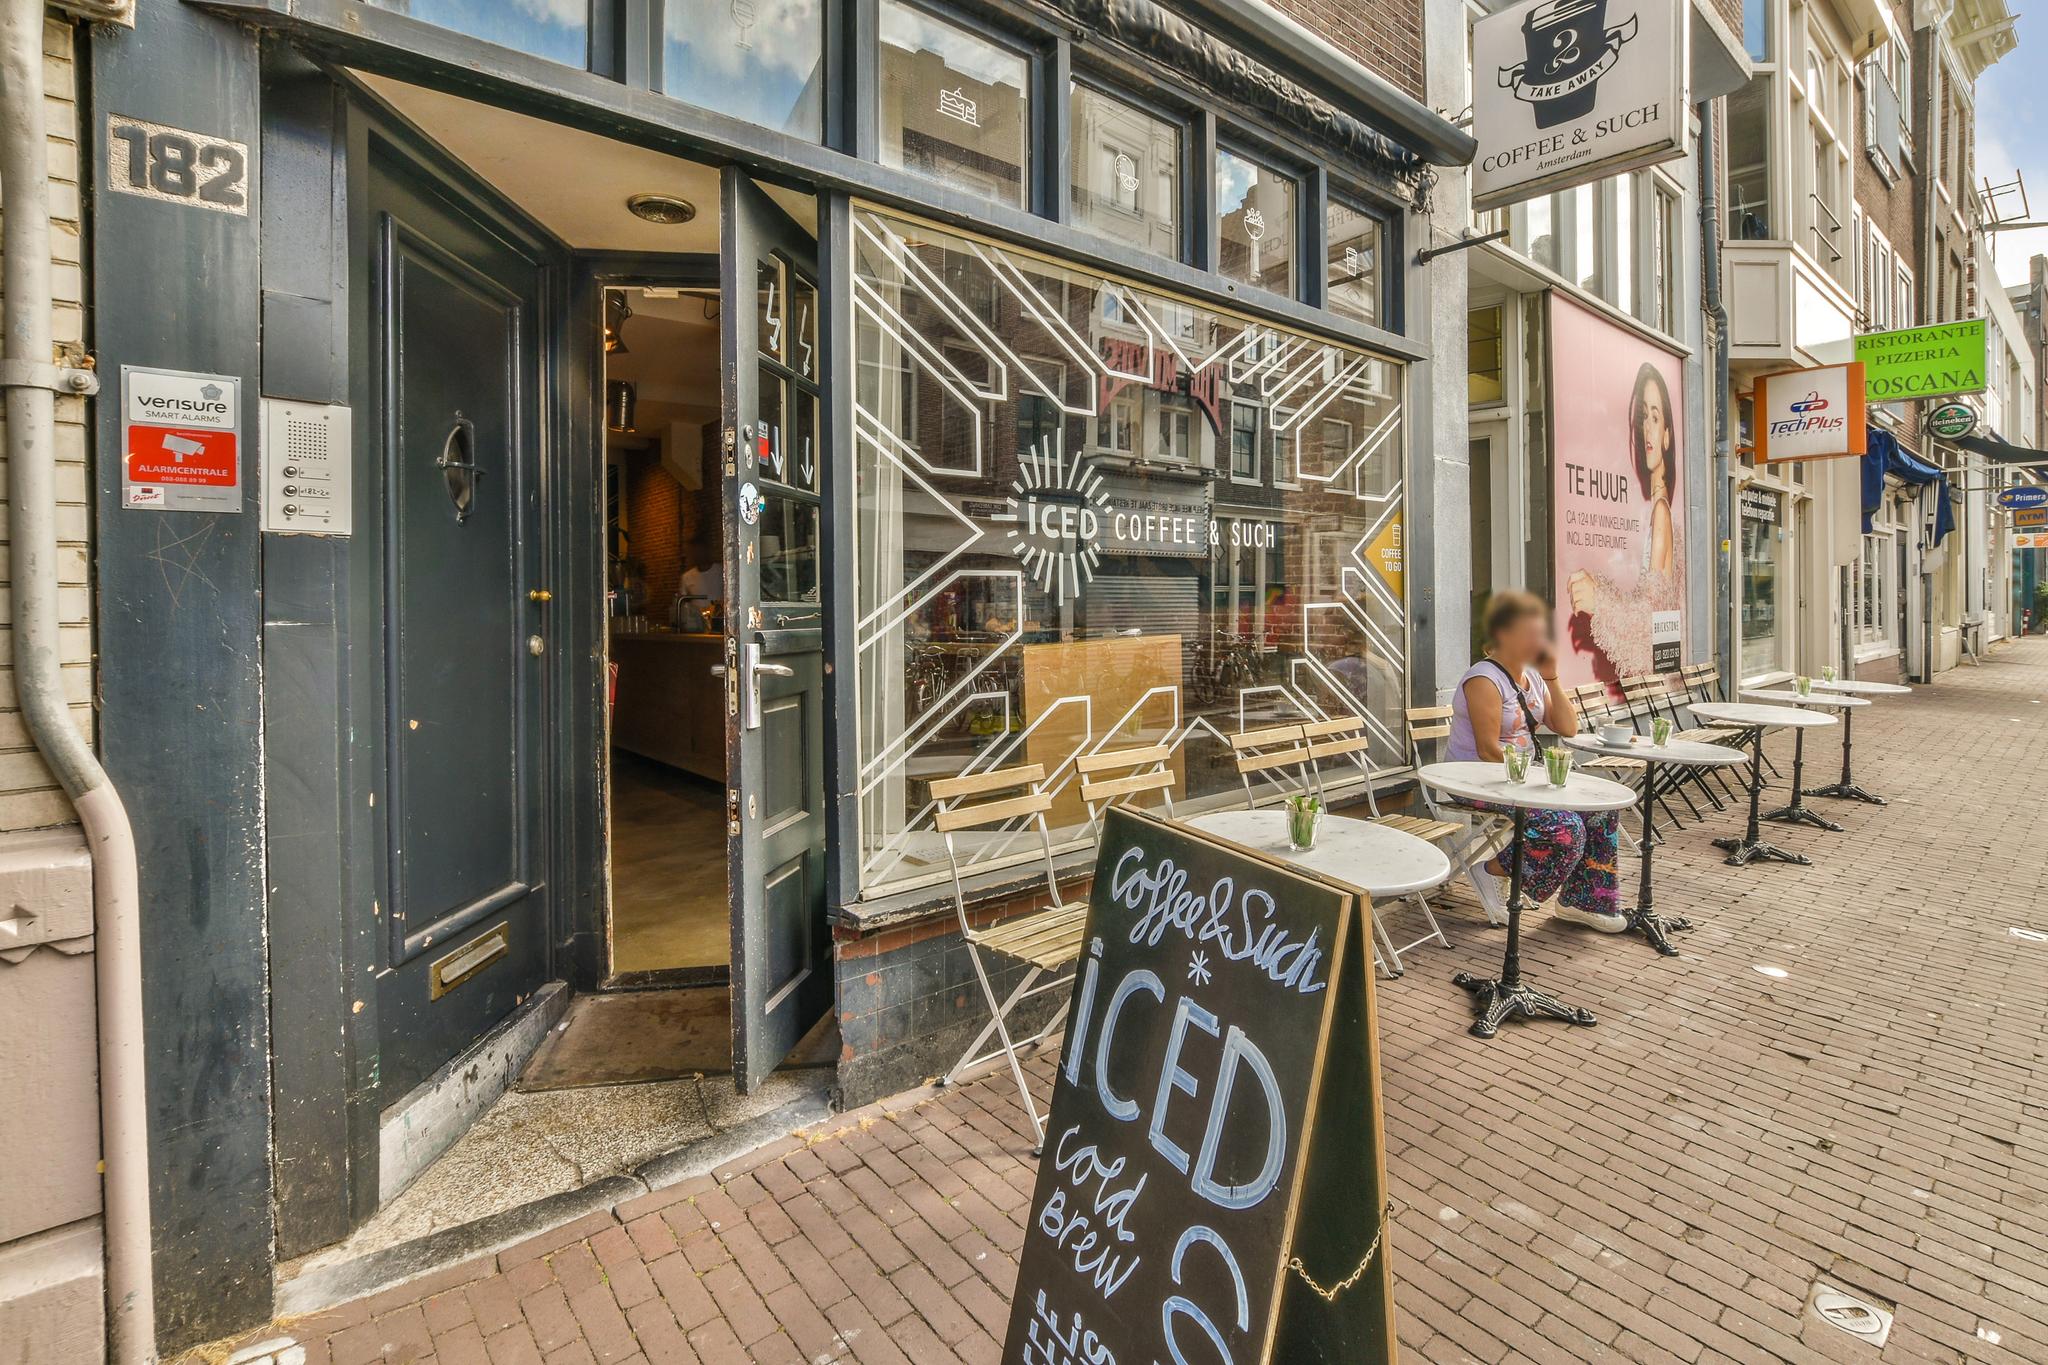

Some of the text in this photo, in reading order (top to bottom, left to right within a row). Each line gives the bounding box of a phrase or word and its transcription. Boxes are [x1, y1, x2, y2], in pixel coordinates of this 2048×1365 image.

[1543, 28, 1580, 75] 2
[1529, 61, 1605, 98] TAKE AWAY
[1482, 102, 1660, 173] COFFEE & SUCH
[113, 125, 244, 207] 182
[1536, 148, 1592, 171] Amsterdam
[1857, 325, 1980, 350] RISTORANTE
[1875, 347, 1960, 366] PIZZERIA
[138, 396, 227, 413] verisure
[145, 410, 221, 424] SMART ALARMS
[1770, 416, 1844, 435] TechPlus
[1932, 417, 1971, 426] Heineken
[138, 464, 229, 477] ALARMCENTRALE
[1565, 463, 1628, 504] TE HUUR
[2015, 493, 2046, 502] Primera
[1566, 510, 1577, 524] CA
[2019, 513, 2044, 521] ATM
[1114, 513, 1196, 544] COFFEE
[1209, 521, 1220, 546] &
[1231, 522, 1275, 548] SUCH
[1381, 548, 1402, 559] COFFEE
[1385, 561, 1402, 572] TO GO
